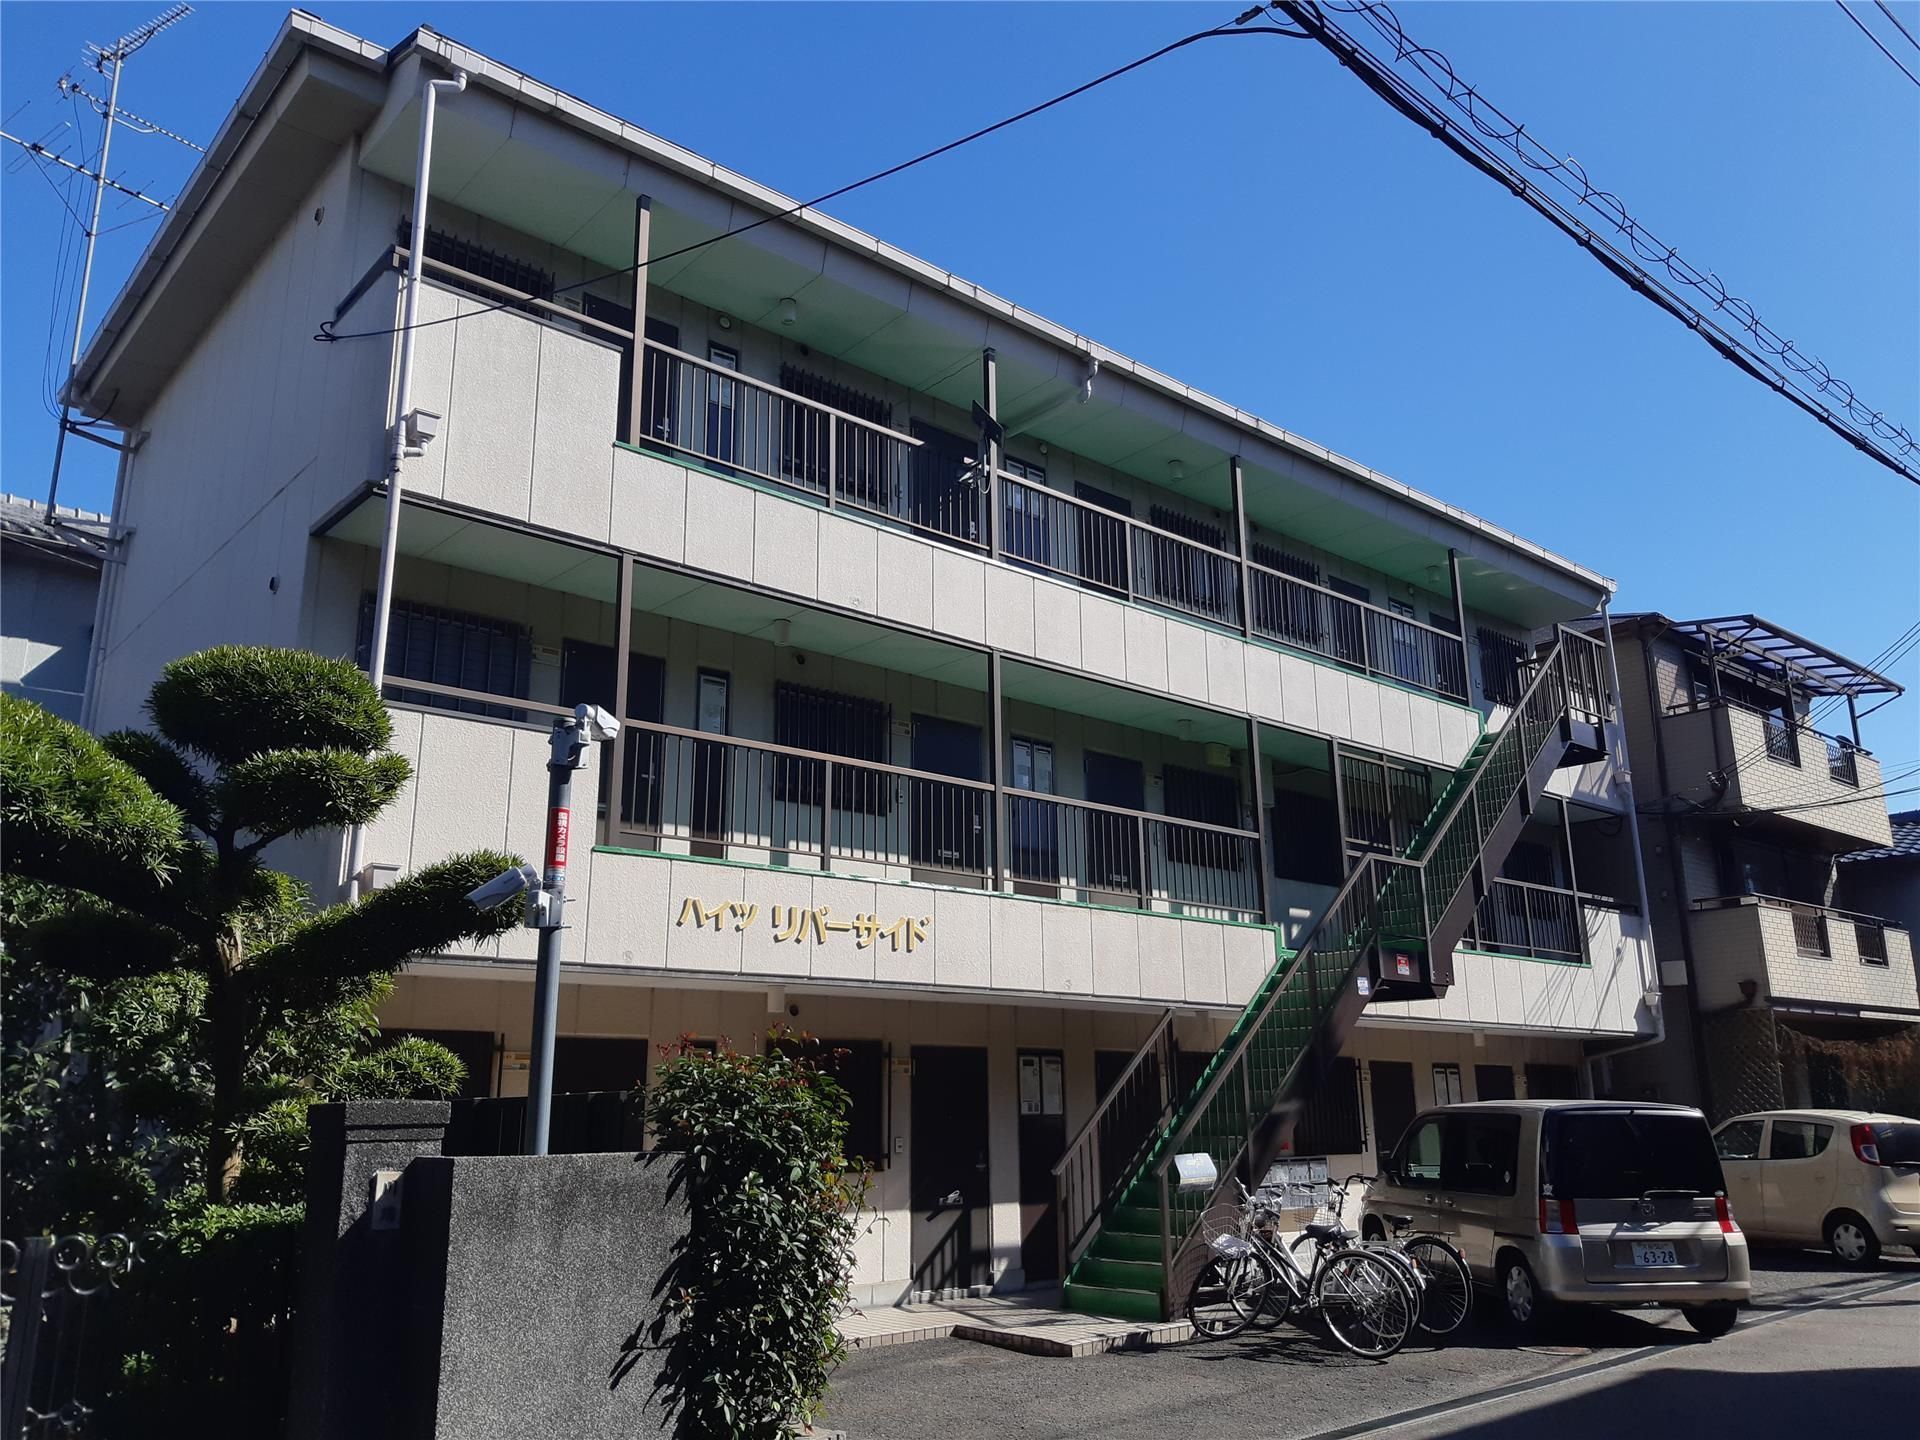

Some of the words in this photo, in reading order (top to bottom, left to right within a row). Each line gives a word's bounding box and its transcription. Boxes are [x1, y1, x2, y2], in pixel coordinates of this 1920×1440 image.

[676, 897, 759, 933] ハイツ
[772, 904, 933, 953] リバーサイド
